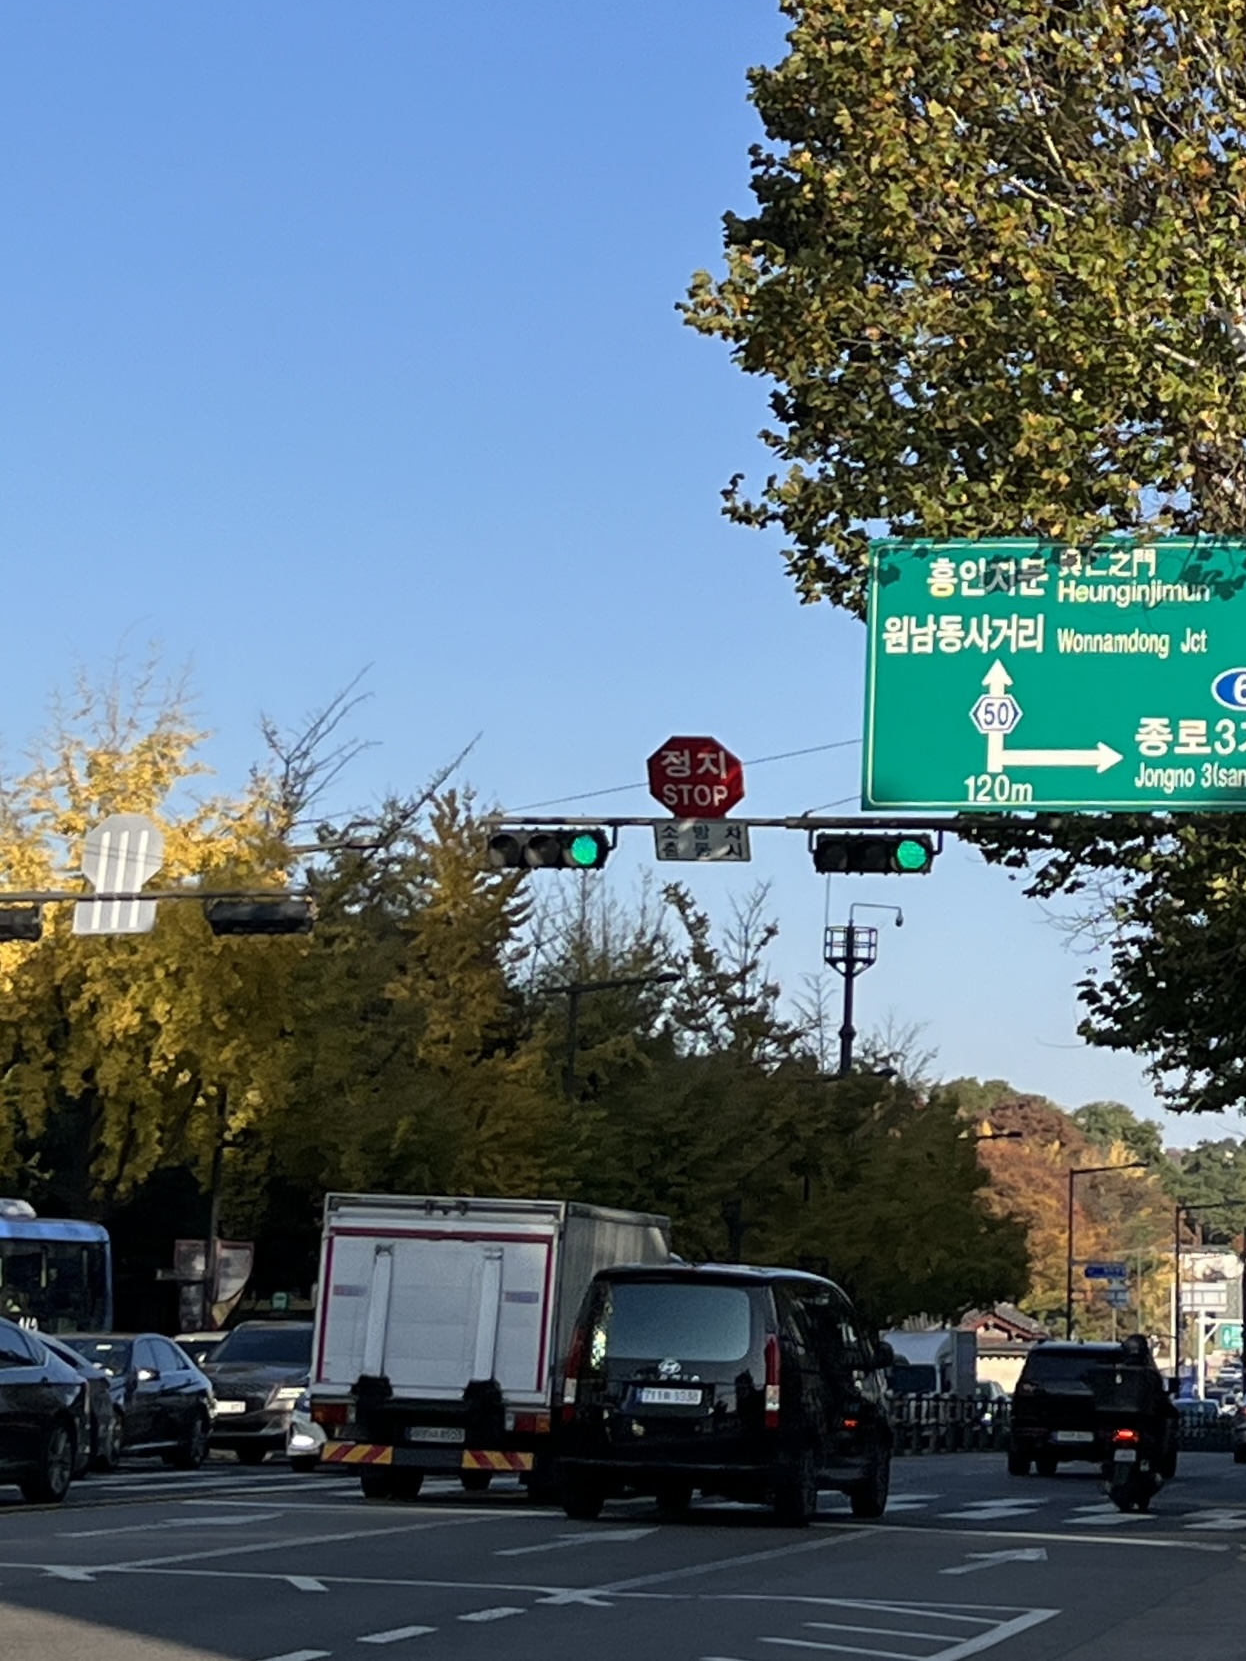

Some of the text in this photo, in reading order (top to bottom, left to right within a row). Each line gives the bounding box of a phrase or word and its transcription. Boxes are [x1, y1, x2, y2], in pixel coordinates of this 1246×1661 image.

[927, 556, 1049, 598] 흥인지문
[1056, 578, 1211, 609] Heunginjimun
[881, 612, 1209, 660] 원남동사거리 Wonnamdong Jct
[982, 702, 1010, 727] 50
[660, 749, 728, 780] 정지
[1134, 762, 1196, 790] Jongno
[662, 783, 729, 807] STOP
[963, 774, 1034, 803] 120m
